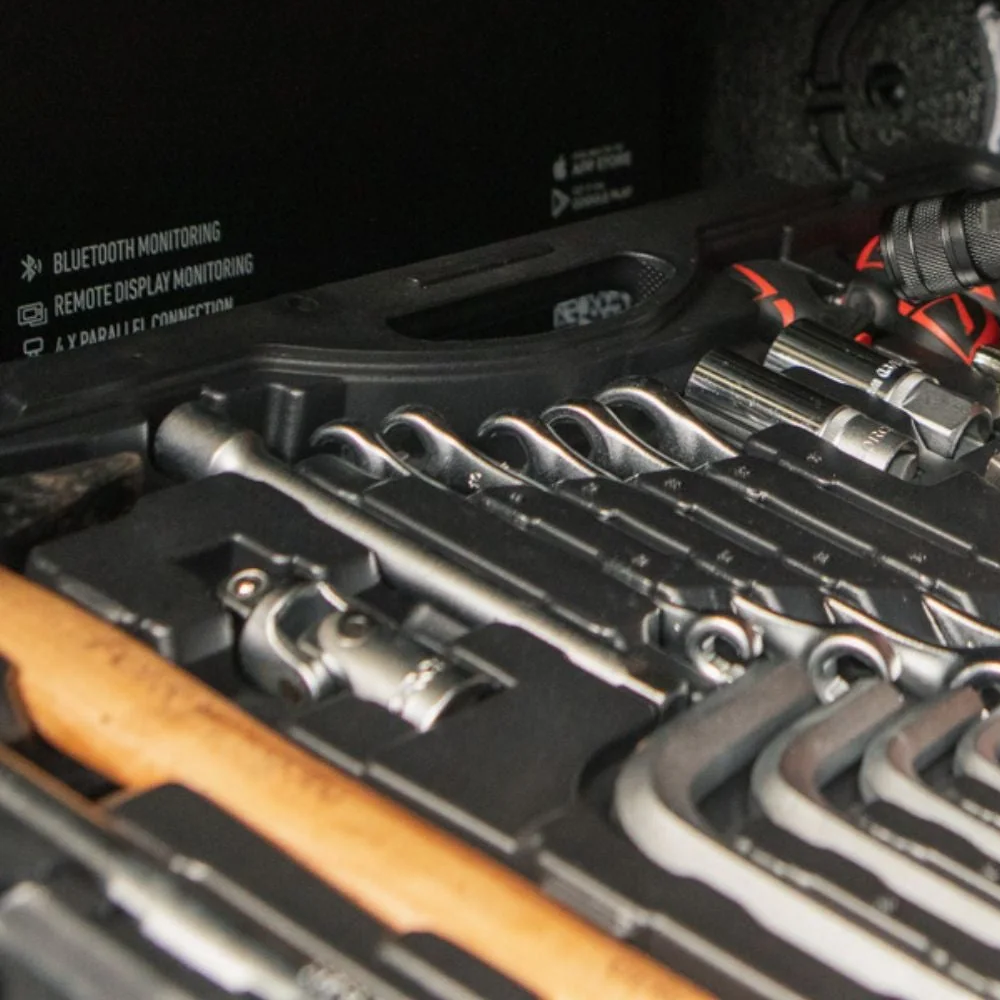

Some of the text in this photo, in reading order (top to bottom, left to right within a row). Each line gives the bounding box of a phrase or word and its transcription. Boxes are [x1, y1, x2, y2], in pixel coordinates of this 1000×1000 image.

[53, 220, 221, 275] BLUETOOTH MONITORING
[54, 253, 254, 317] REMOTE DISPLAY MONITORING
